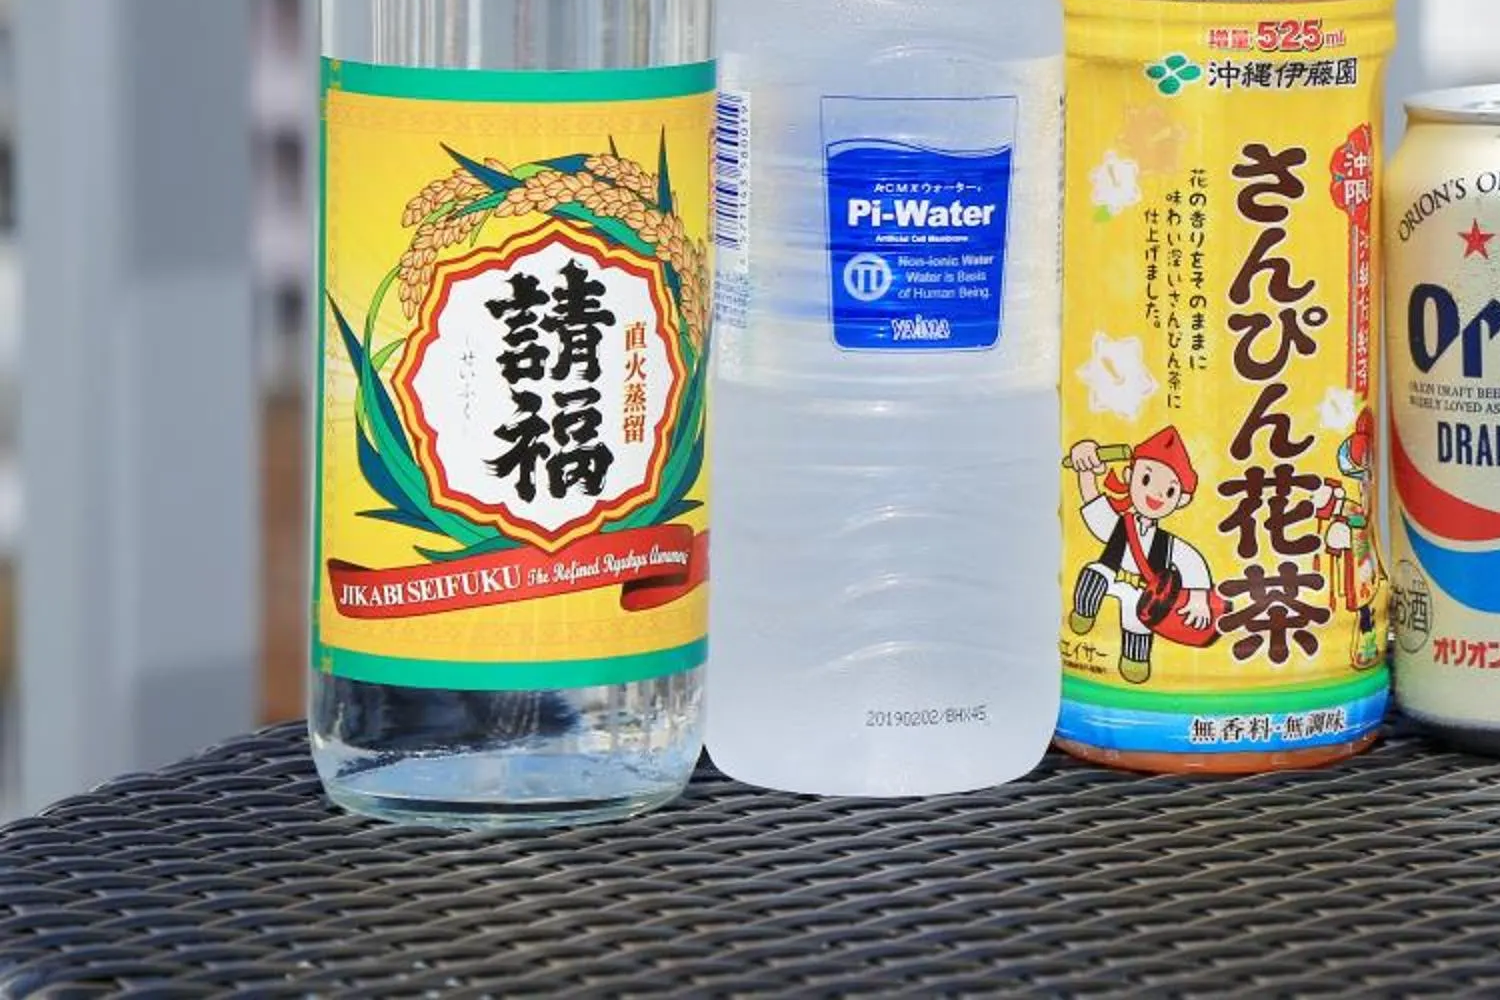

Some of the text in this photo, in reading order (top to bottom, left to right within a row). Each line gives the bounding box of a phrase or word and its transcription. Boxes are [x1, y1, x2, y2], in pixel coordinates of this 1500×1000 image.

[1208, 57, 1358, 89] 沖縄伊藤園
[848, 199, 996, 228] Pi-Water
[1398, 177, 1467, 244] ORION'S
[906, 270, 942, 283] Water
[943, 270, 955, 283] is
[961, 254, 994, 266] Water
[1144, 208, 1161, 329] 仕上げました。
[1188, 169, 1208, 371] 花の香りをそのままに
[898, 287, 911, 299] of
[913, 287, 956, 299] Human
[1166, 191, 1184, 409] 味わい深いさんぴん茶に
[483, 258, 616, 501] 請福
[624, 322, 649, 445] 直火蒸留
[1218, 143, 1330, 664] さんぴん花茶
[1486, 403, 1500, 415] AS
[340, 564, 523, 607] JIKABI SEIFUKU
[527, 568, 550, 587] The
[553, 556, 600, 585] Refined
